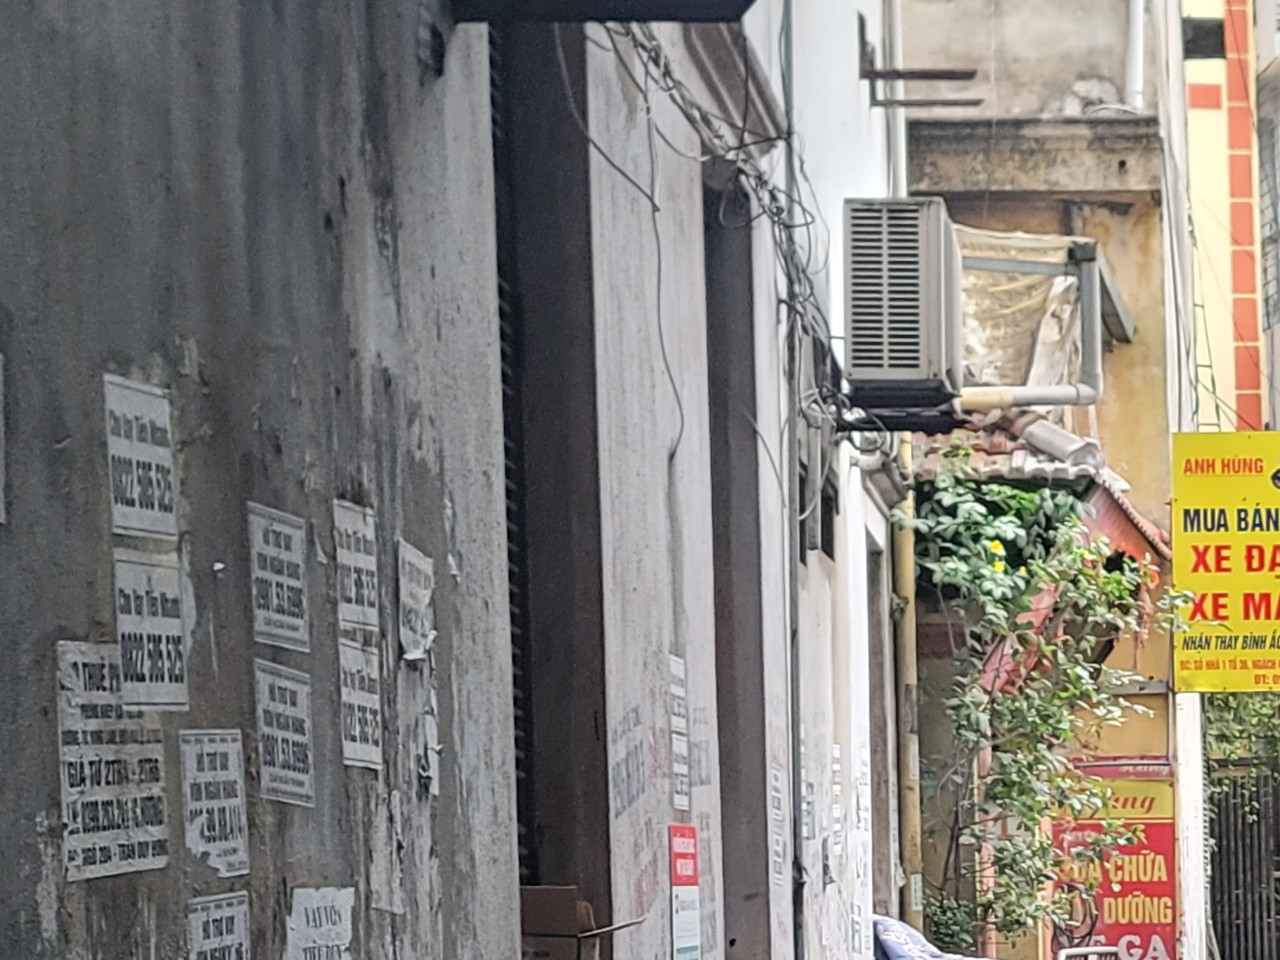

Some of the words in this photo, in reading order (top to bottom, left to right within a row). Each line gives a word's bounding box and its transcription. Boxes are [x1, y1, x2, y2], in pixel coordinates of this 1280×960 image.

[1183, 458, 1215, 476] ANH
[1221, 455, 1264, 475] HÙNG
[1183, 508, 1229, 532] MUA
[1237, 503, 1280, 532] BÁN
[1191, 545, 1232, 573] XE
[1188, 593, 1230, 621] XE
[1182, 633, 1211, 652] NHẬN
[1215, 635, 1239, 649] THAY
[1241, 632, 1267, 649] BÌNH
[1109, 850, 1168, 882] CHỮA
[1103, 891, 1172, 924] DƯỠNG
